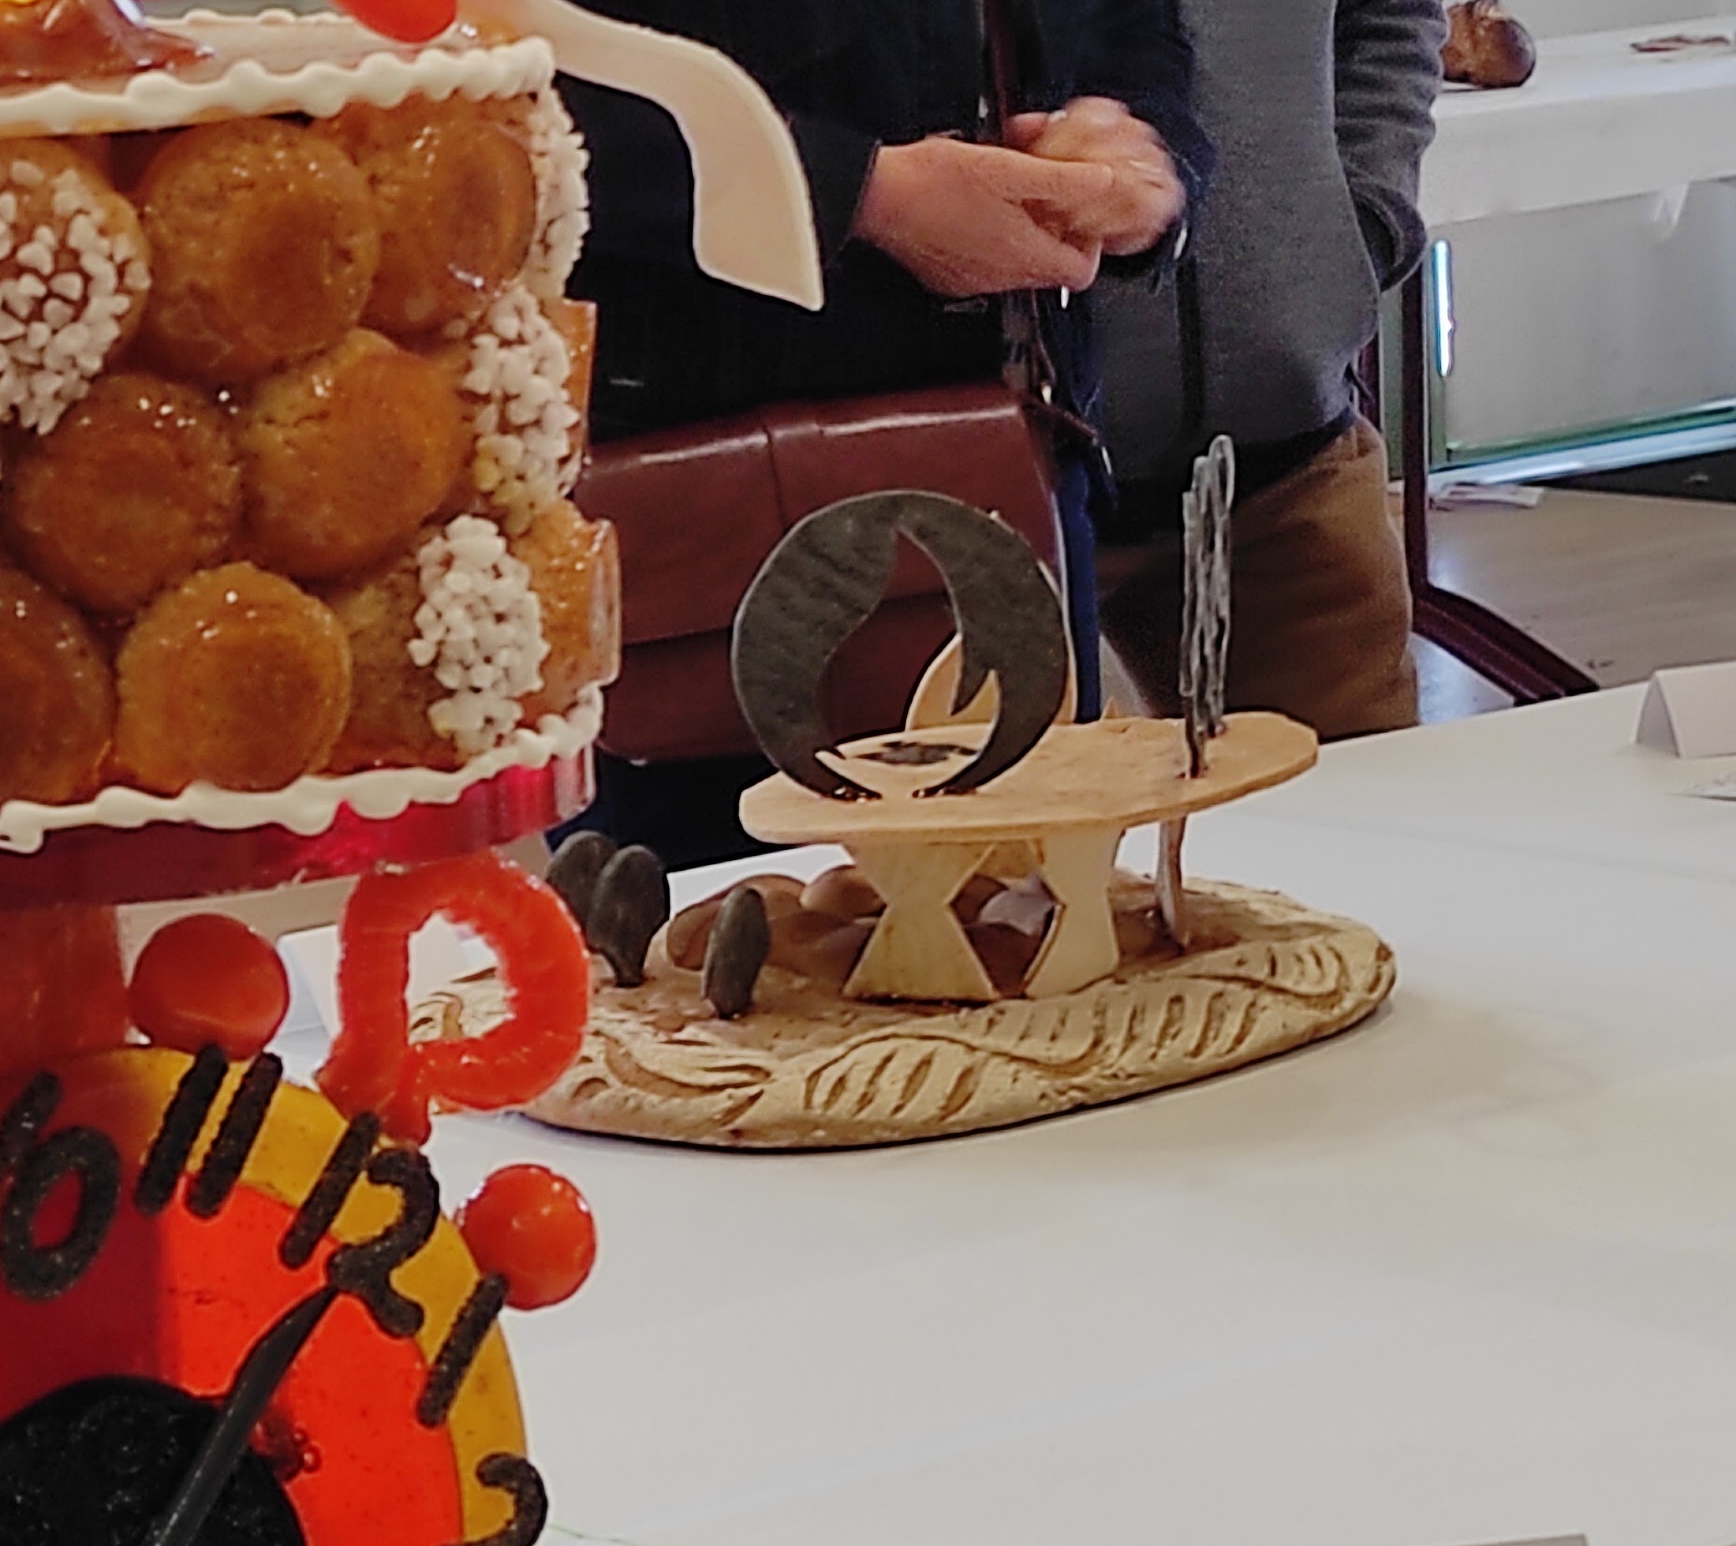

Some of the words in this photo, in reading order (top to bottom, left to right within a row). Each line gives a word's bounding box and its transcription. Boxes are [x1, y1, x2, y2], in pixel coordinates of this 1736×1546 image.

[134, 1045, 284, 1217] 11
[279, 1112, 440, 1335] 12
[417, 1273, 510, 1427] 1
